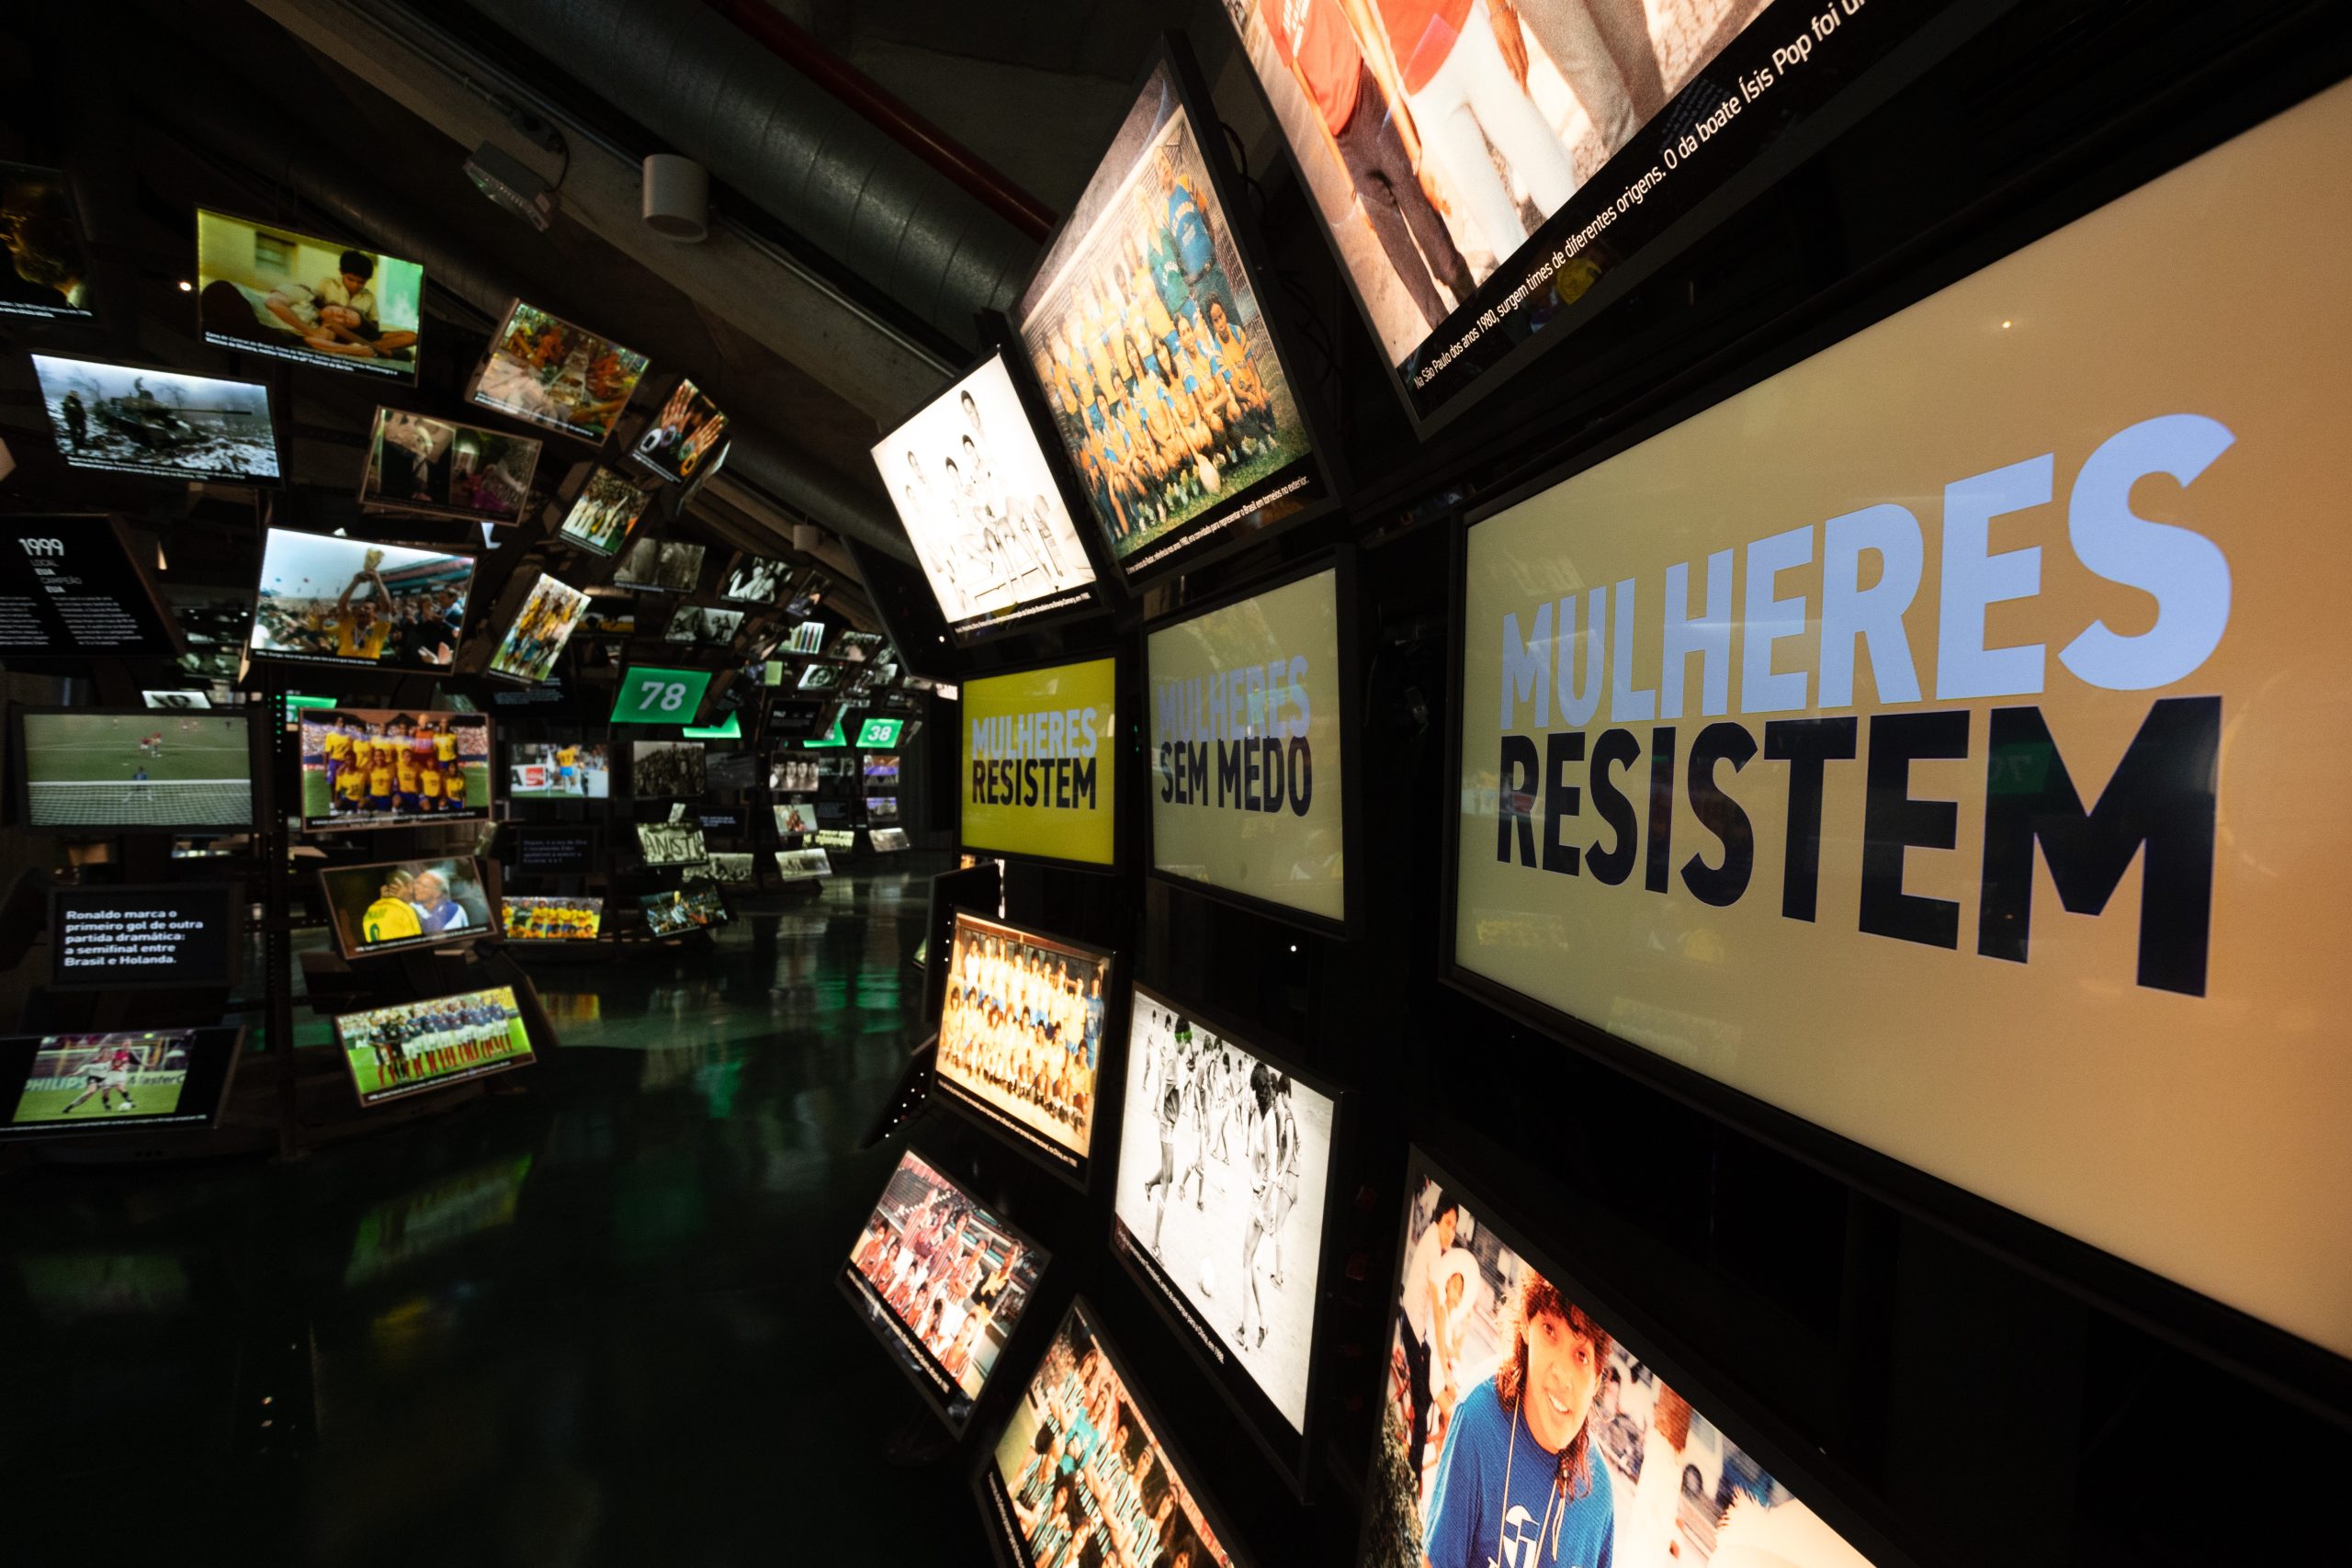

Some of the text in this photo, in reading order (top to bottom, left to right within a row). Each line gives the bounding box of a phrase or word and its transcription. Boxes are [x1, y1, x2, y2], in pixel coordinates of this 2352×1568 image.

[1414, 377, 1424, 389] Na
[1421, 367, 1435, 383] São
[1431, 353, 1453, 374] Paulo
[1450, 344, 1464, 358] dos
[1461, 327, 1480, 348] anos
[1476, 310, 1500, 333] 1980,
[1497, 284, 1530, 317] surgem
[1526, 262, 1554, 290] times
[1552, 251, 1566, 269] de
[1565, 206, 1617, 257] diferentes
[1616, 166, 1667, 213] origens.
[1663, 148, 1678, 170] O
[1678, 133, 1699, 159] da
[1695, 96, 1742, 142] boate
[1737, 67, 1774, 103] Ísis
[1771, 34, 1812, 76] Pop
[1811, 2, 1841, 42] foi
[1242, 500, 1257, 515] Brasil
[1255, 499, 1265, 508] em
[1262, 490, 1283, 504] torneios
[1281, 486, 1289, 495] no
[1287, 476, 1310, 491] exterior.
[18, 537, 64, 556] 1999
[34, 568, 56, 576] EUA
[40, 576, 83, 585] CAMPEÃO
[1500, 413, 2235, 729] MULHERES
[44, 585, 66, 593] EUA
[639, 682, 686, 711] 78
[1159, 655, 1311, 746] MULHERES
[867, 726, 892, 741] 38
[972, 707, 1097, 761] MULHERES
[972, 757, 1096, 809] RESISTEM
[1160, 736, 1312, 817] SEM MEDO
[1497, 695, 2222, 998] RESISTEM
[66, 910, 121, 919] Ronaldo
[65, 920, 203, 932] primeiro gol de outra
[65, 931, 186, 944] partida dramática:
[76, 944, 137, 954] semifinal
[141, 944, 175, 953] entre
[64, 956, 105, 966] Brasil
[119, 955, 176, 964] Holanda.
